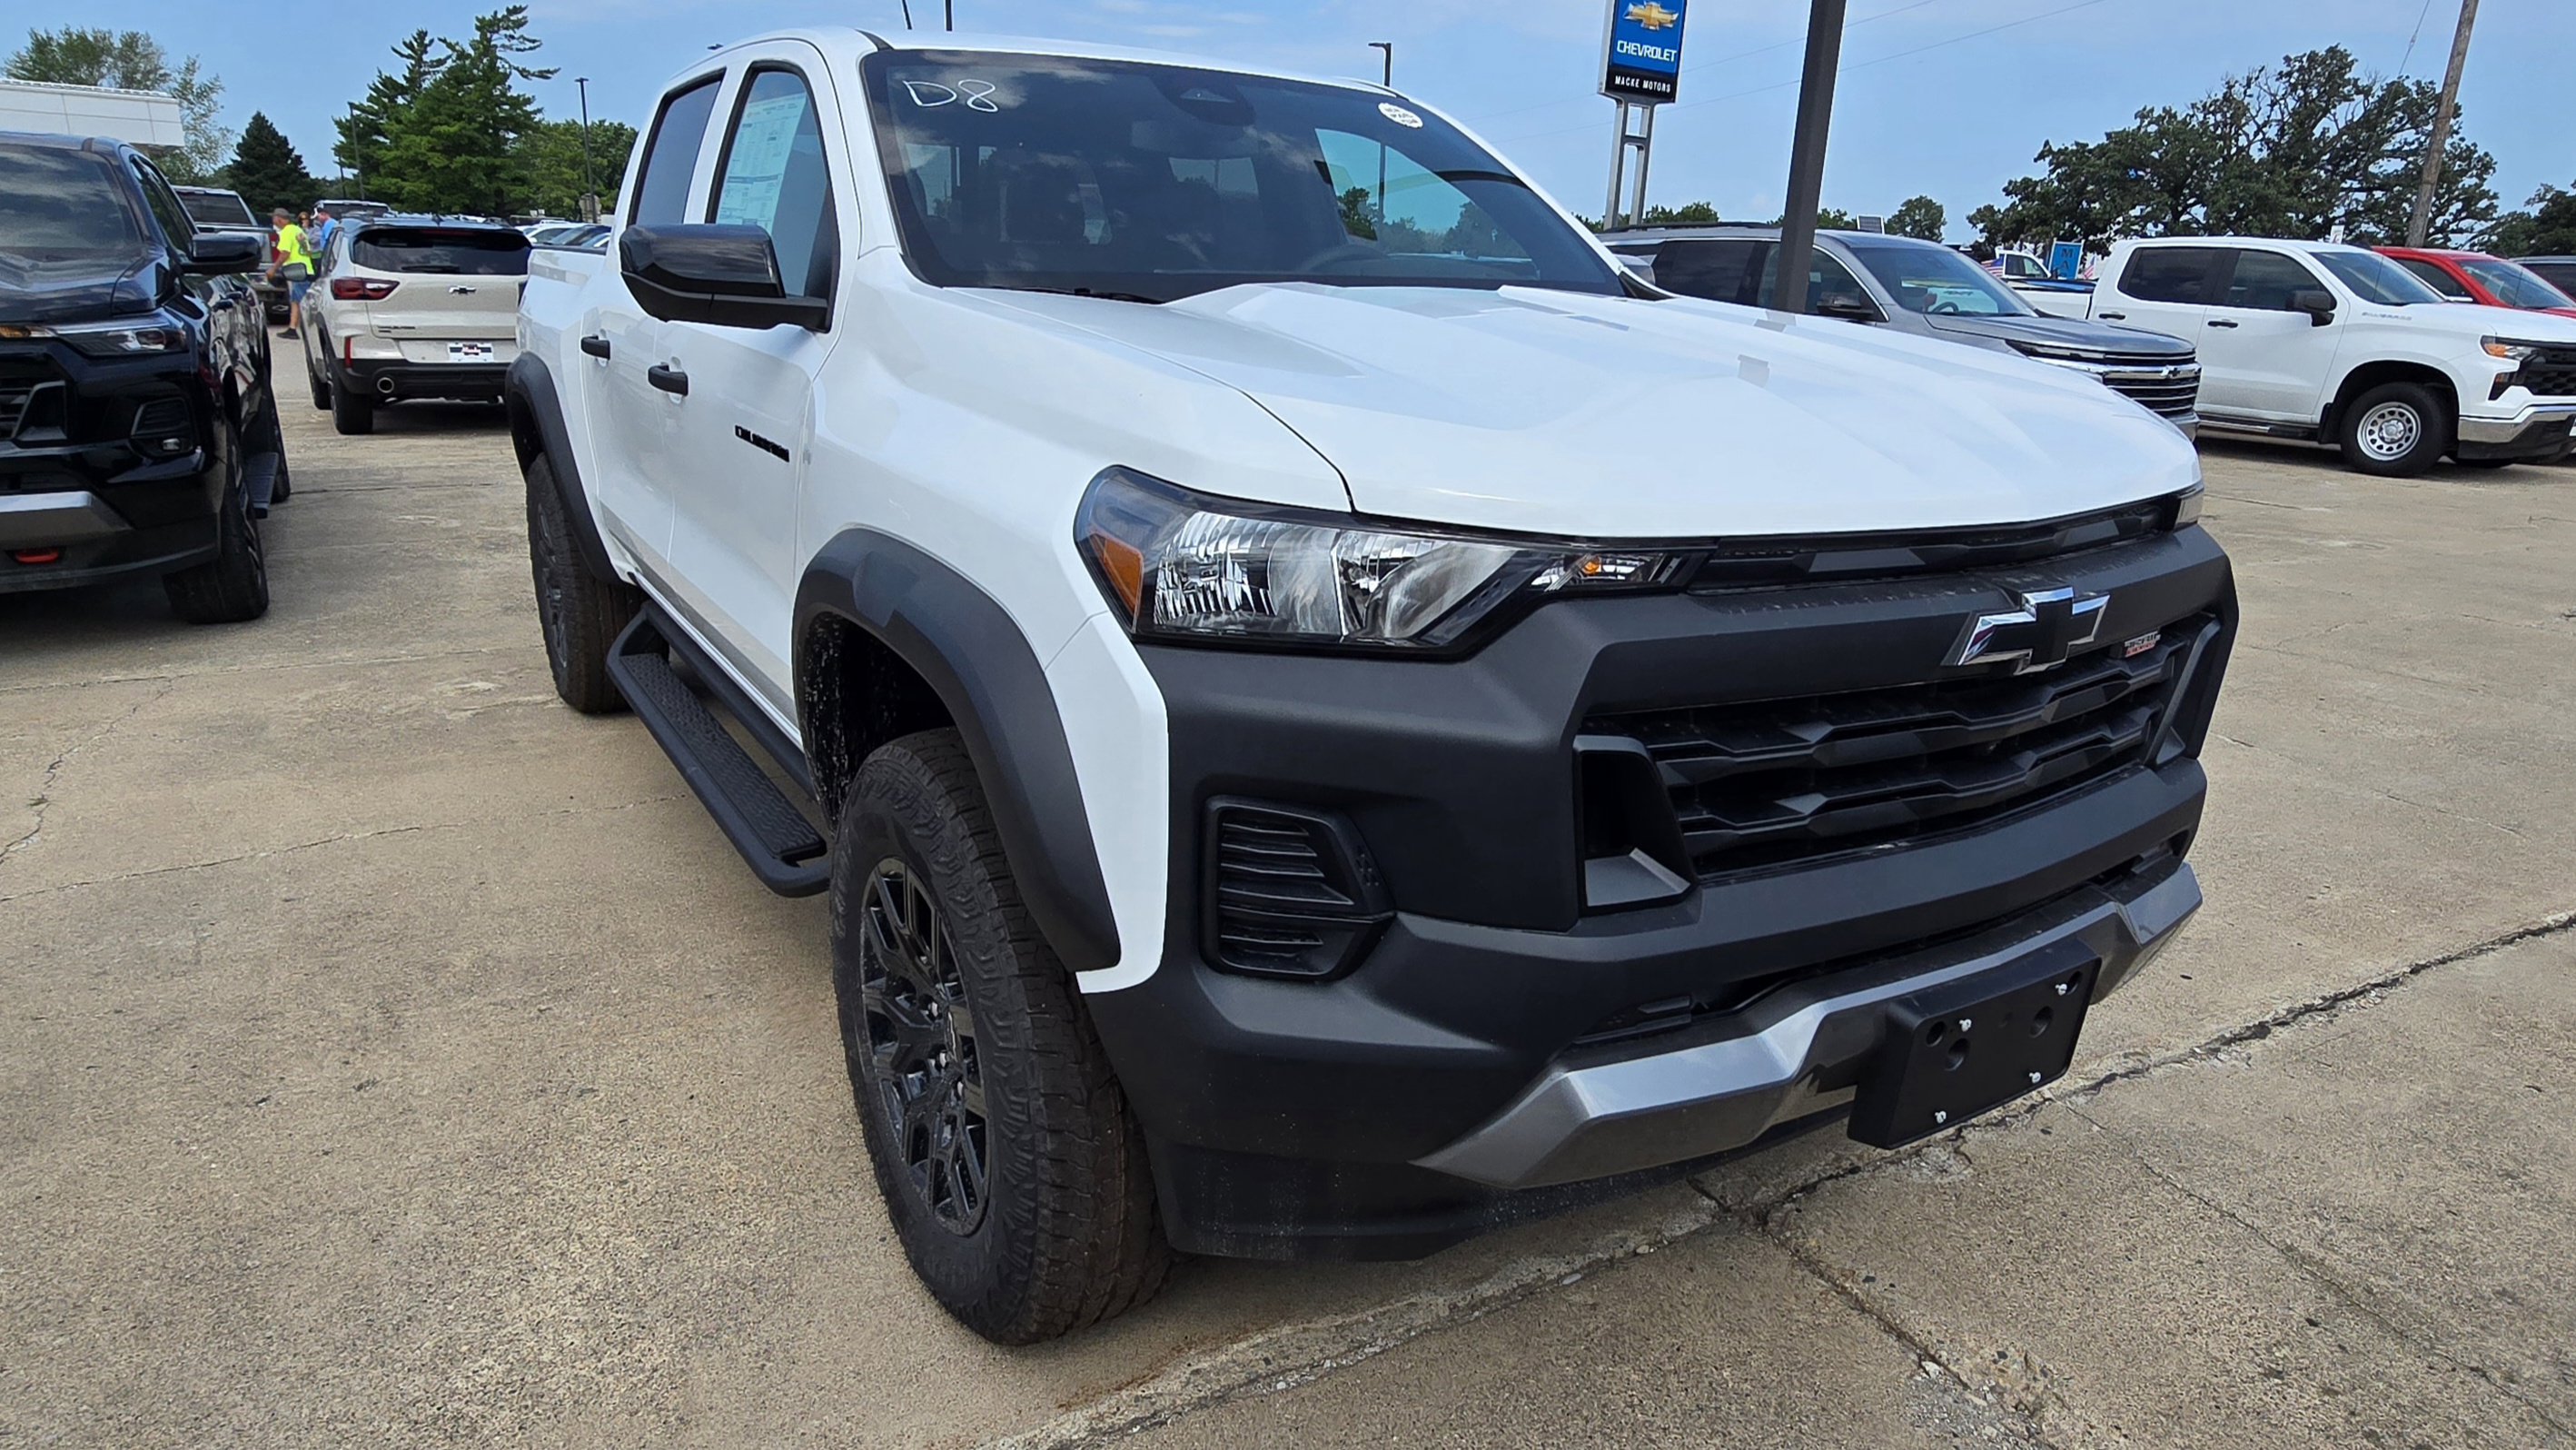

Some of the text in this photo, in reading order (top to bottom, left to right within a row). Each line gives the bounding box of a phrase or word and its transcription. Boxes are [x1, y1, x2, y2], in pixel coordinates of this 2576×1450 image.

[1617, 40, 1678, 62] CHEVROLET
[1614, 75, 1671, 93] MACKE MOTORS
[902, 78, 999, 113] D8
